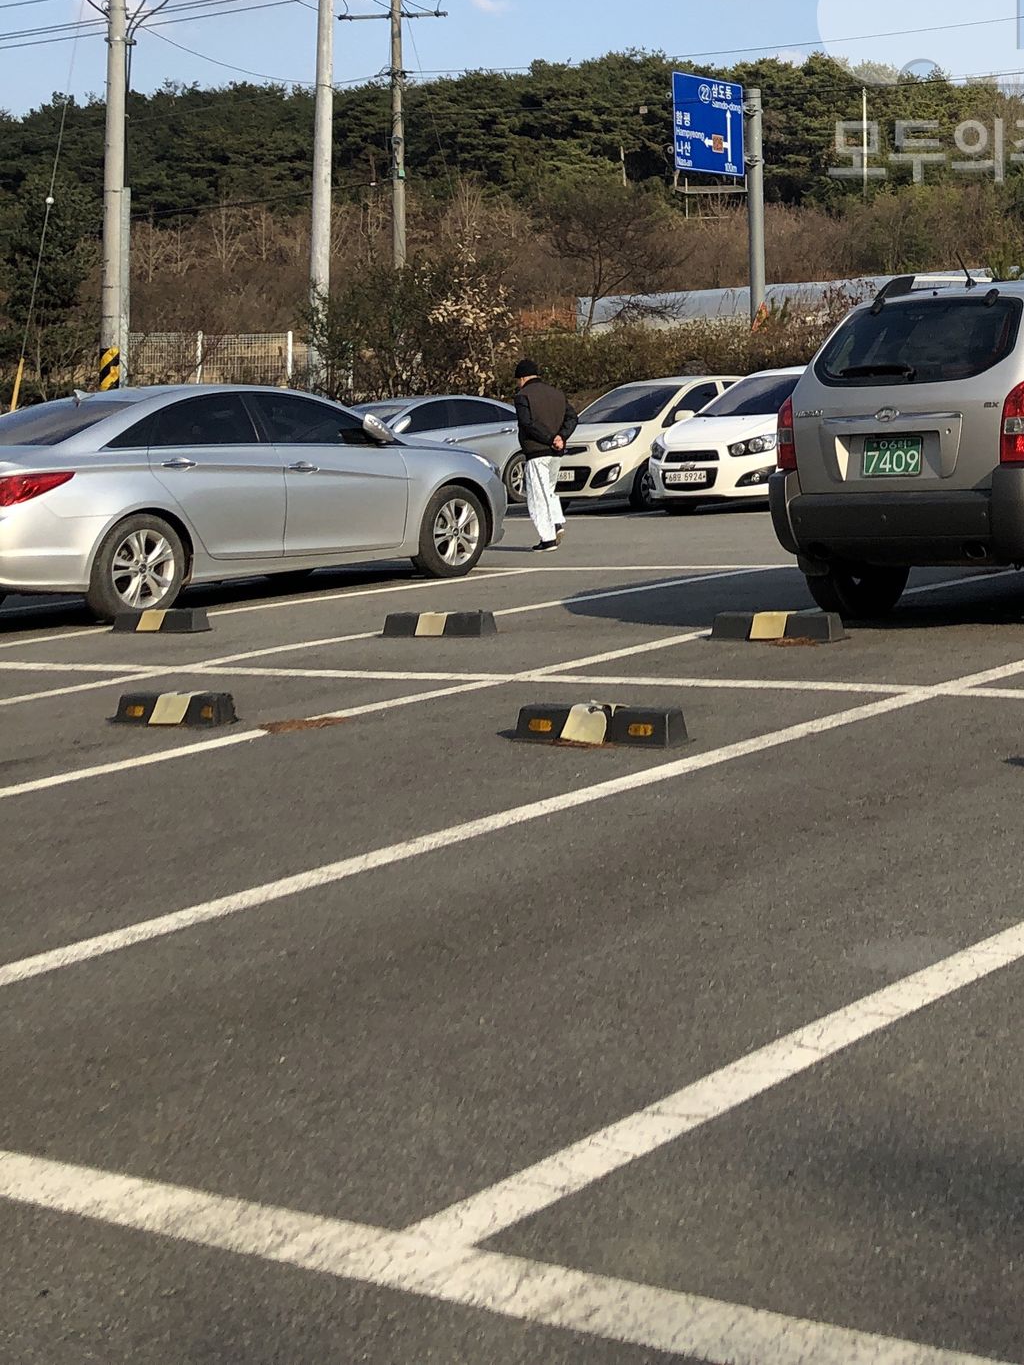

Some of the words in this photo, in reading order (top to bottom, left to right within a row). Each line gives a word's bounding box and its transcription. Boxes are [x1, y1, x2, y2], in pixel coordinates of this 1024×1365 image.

[711, 83, 732, 100] 삼도동
[676, 110, 691, 126] 함평
[676, 140, 691, 156] 나산
[867, 450, 919, 473] 7409
[684, 472, 703, 482] 5924
